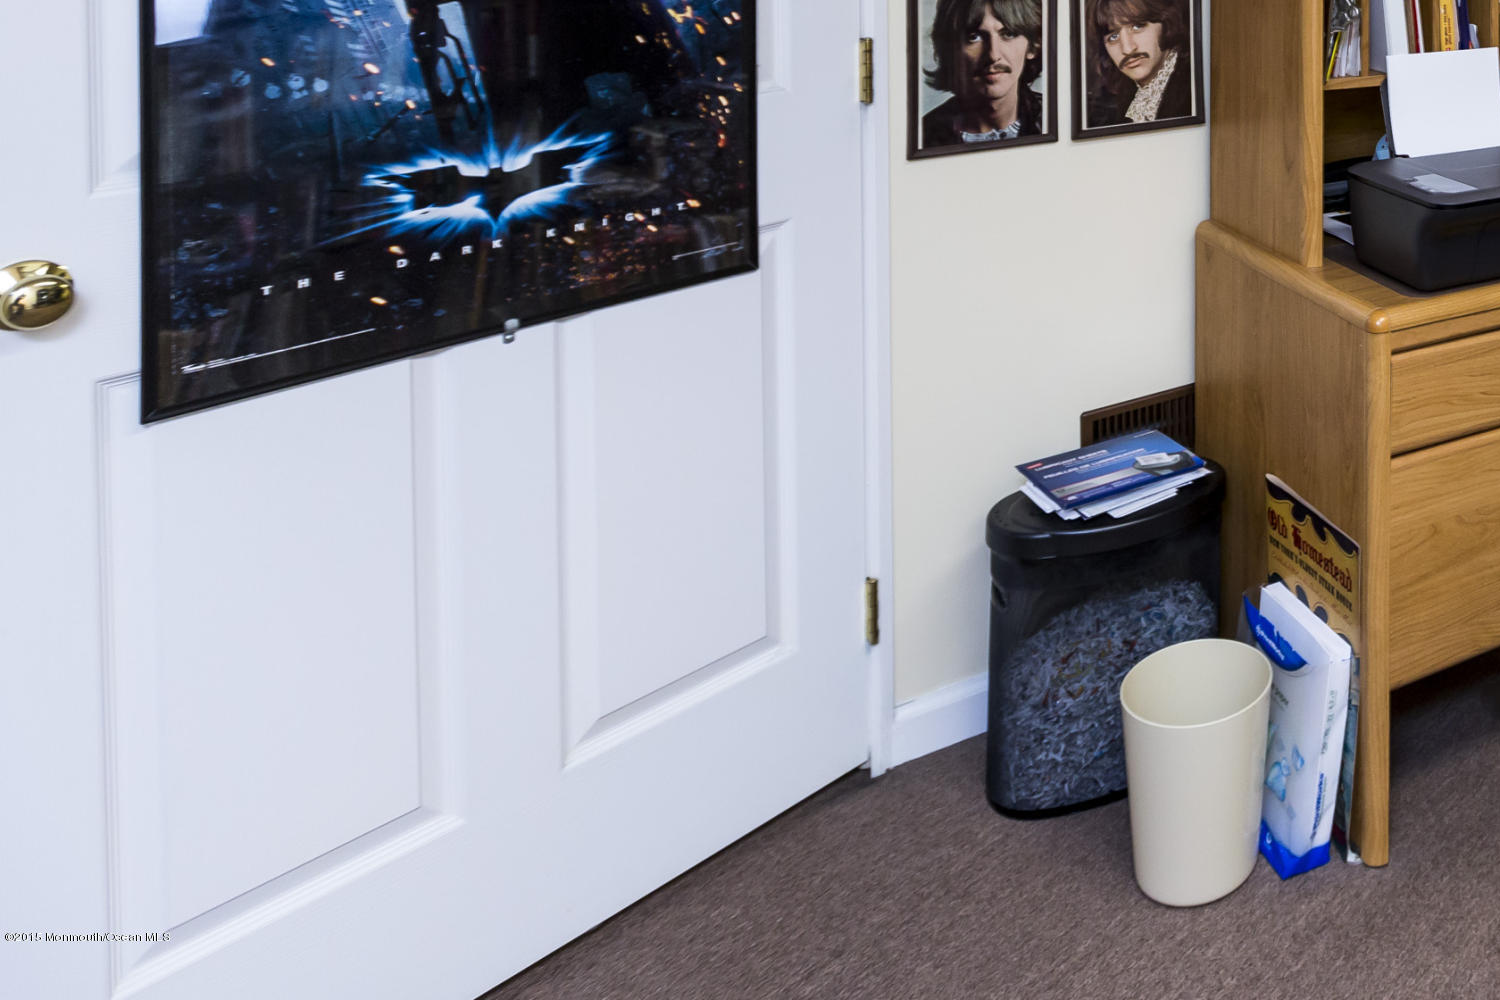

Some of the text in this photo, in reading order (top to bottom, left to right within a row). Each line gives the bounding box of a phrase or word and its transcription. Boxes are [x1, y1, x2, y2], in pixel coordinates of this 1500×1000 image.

[260, 201, 687, 297] THE DARK KNIGHT
[1267, 507, 1288, 540] Old
[1291, 524, 1353, 592] Homestead
